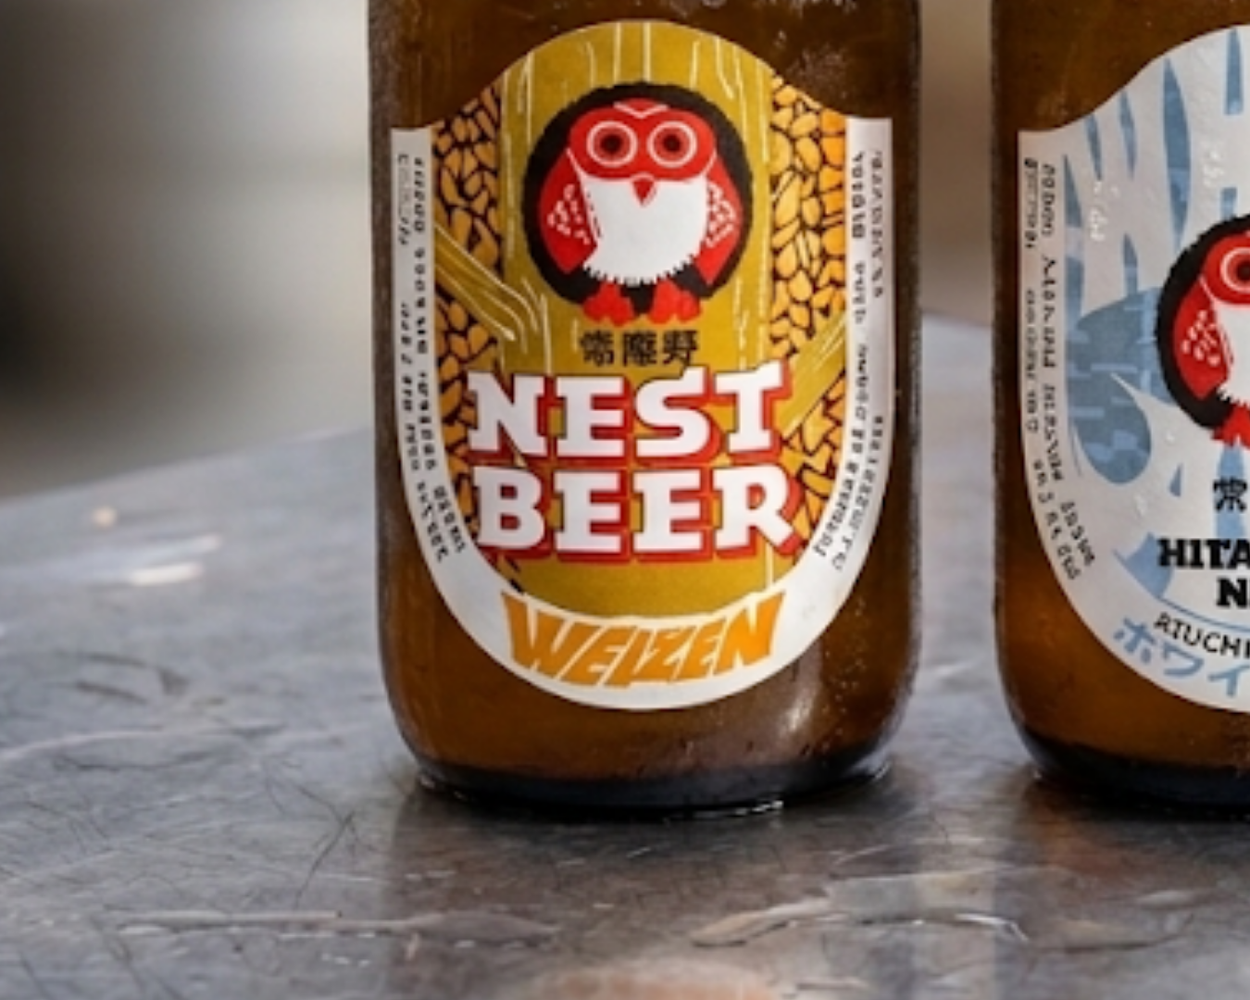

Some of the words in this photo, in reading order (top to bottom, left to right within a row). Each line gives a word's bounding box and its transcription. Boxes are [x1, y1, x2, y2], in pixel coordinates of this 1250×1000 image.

[467, 360, 789, 462] NEST
[473, 464, 798, 560] BEER
[501, 588, 785, 687] WEIZEN
